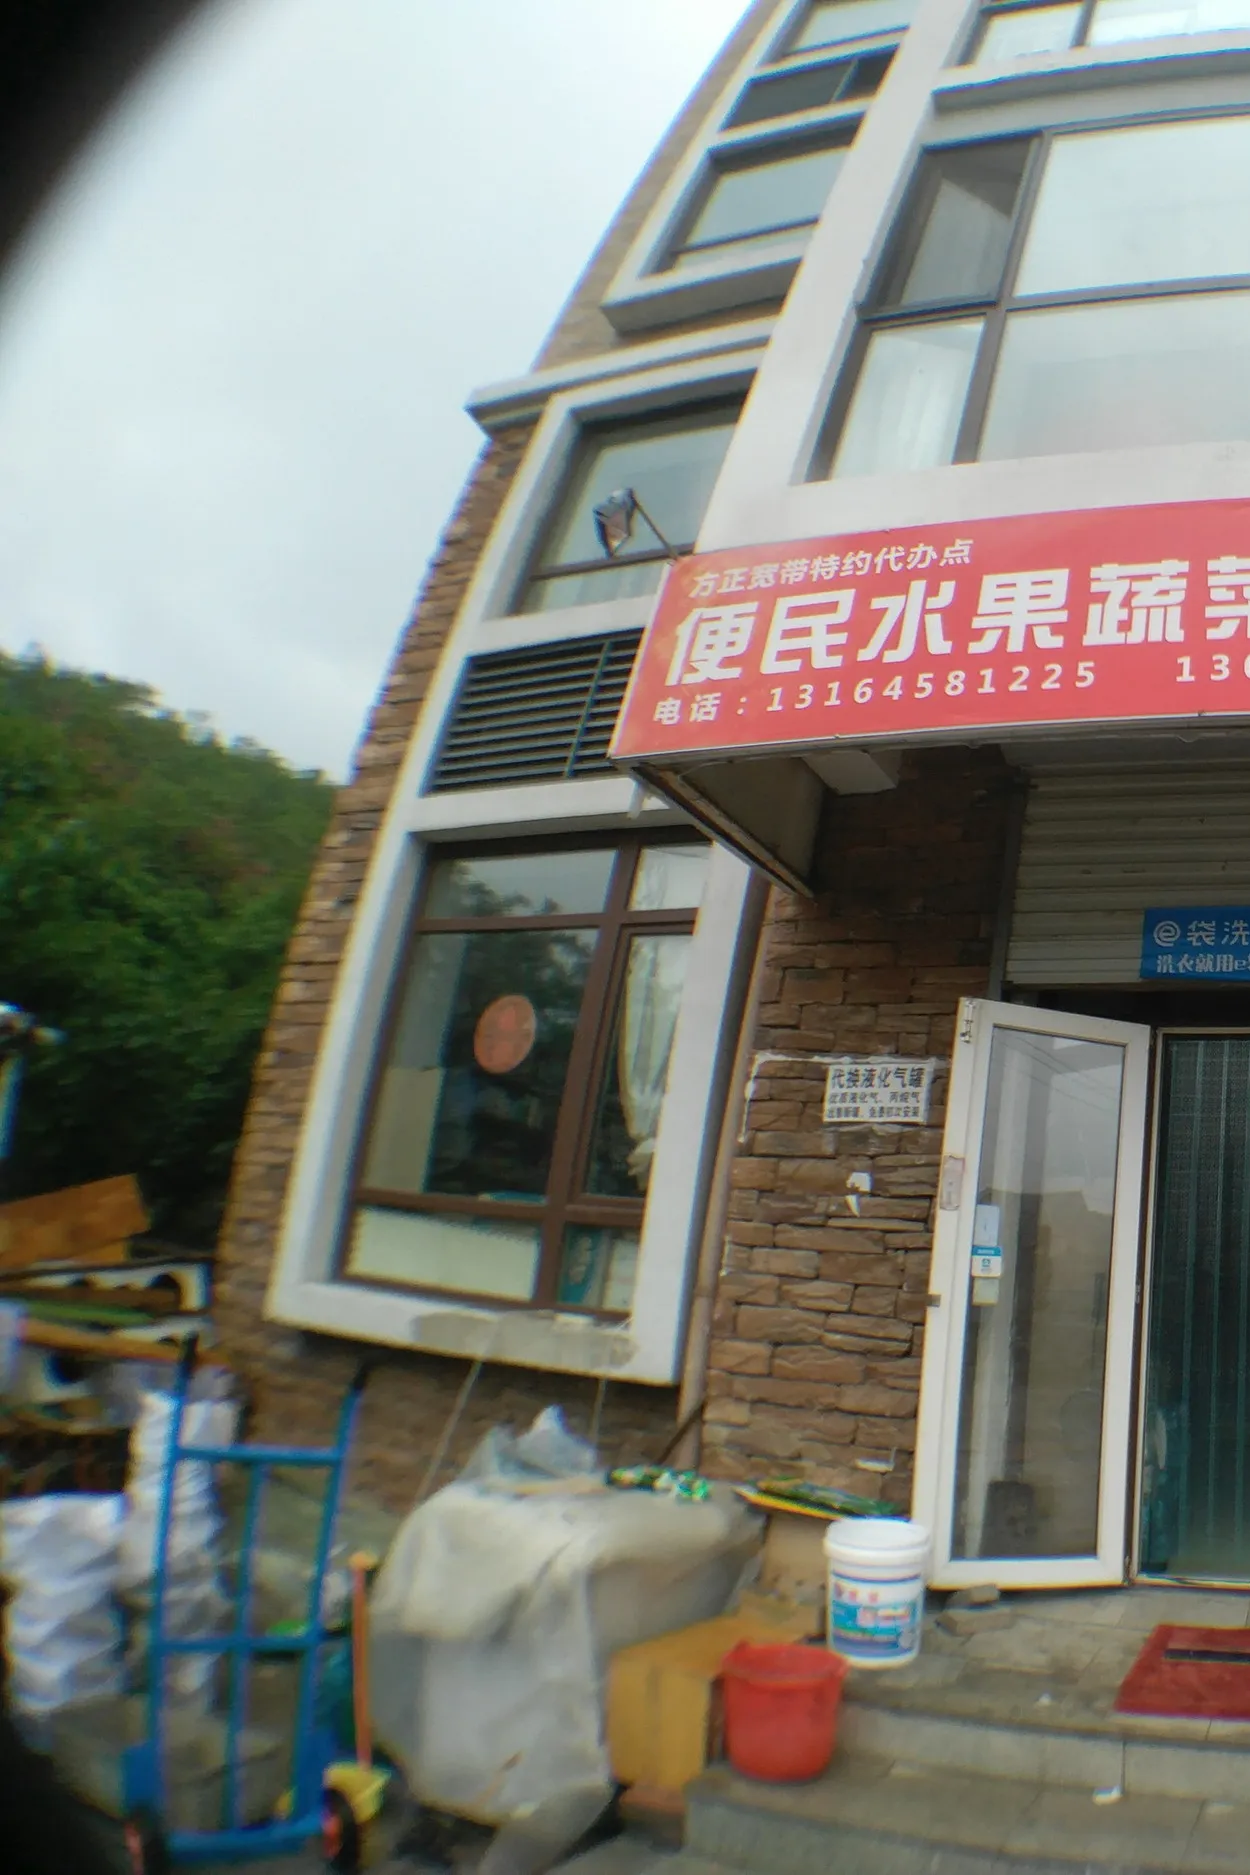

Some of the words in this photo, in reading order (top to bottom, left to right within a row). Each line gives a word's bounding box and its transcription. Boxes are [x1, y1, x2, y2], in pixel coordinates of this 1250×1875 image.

[688, 538, 974, 598] 方正宽带特约代办点
